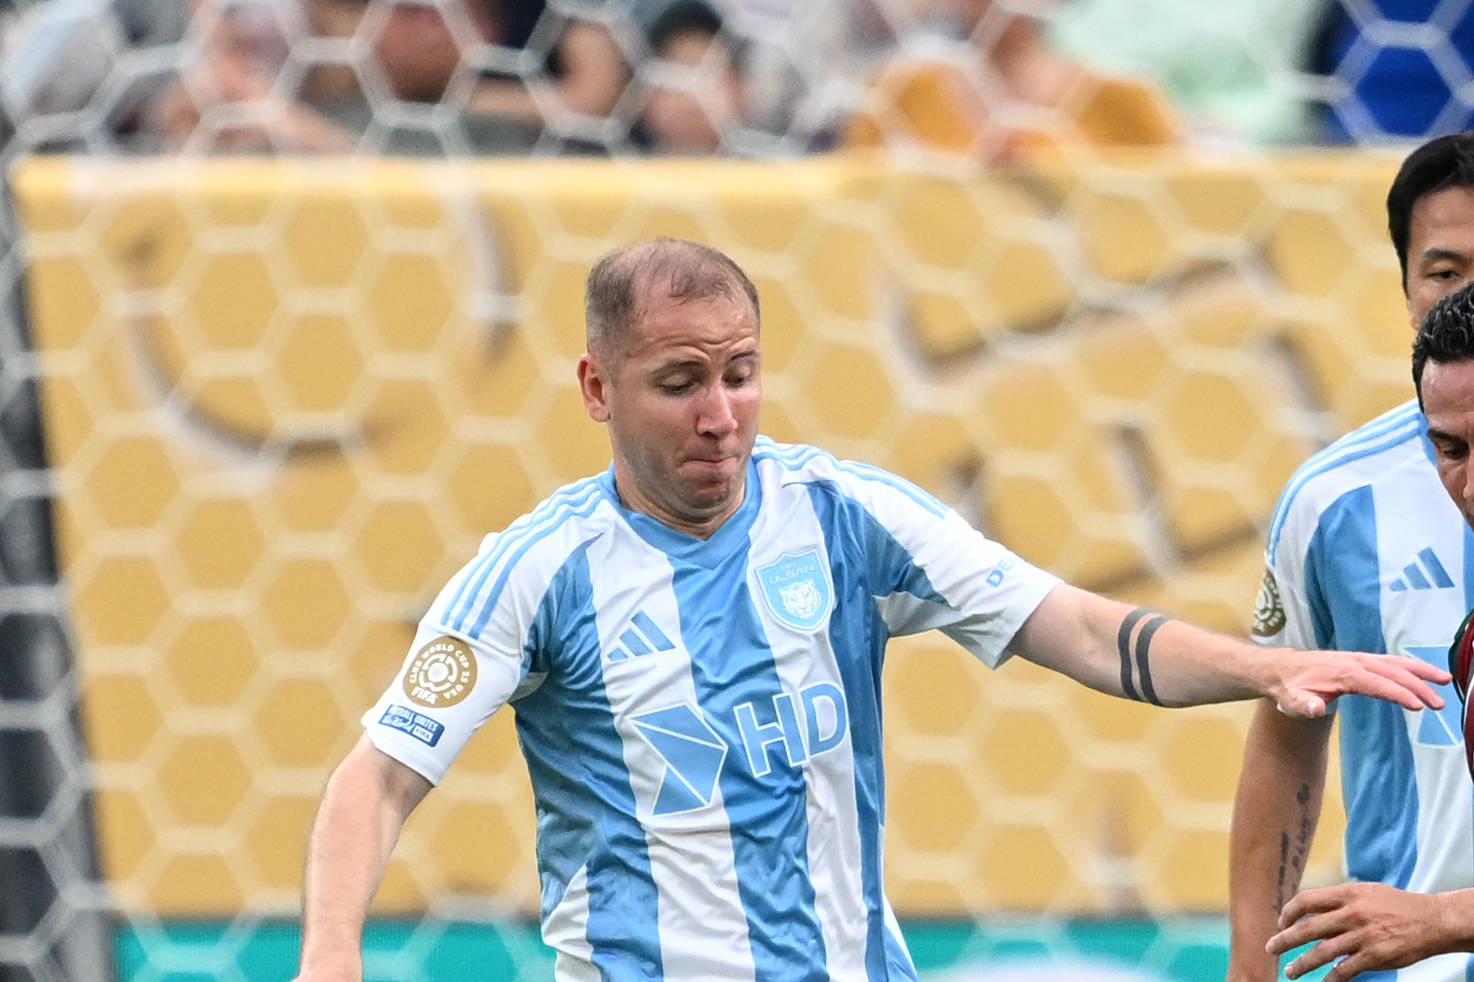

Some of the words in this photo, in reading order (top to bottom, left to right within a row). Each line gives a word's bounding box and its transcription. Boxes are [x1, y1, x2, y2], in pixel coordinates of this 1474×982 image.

[422, 644, 454, 659] WORLD
[455, 650, 470, 668] CUP
[411, 686, 438, 704] FIFA
[733, 681, 848, 778] HD
